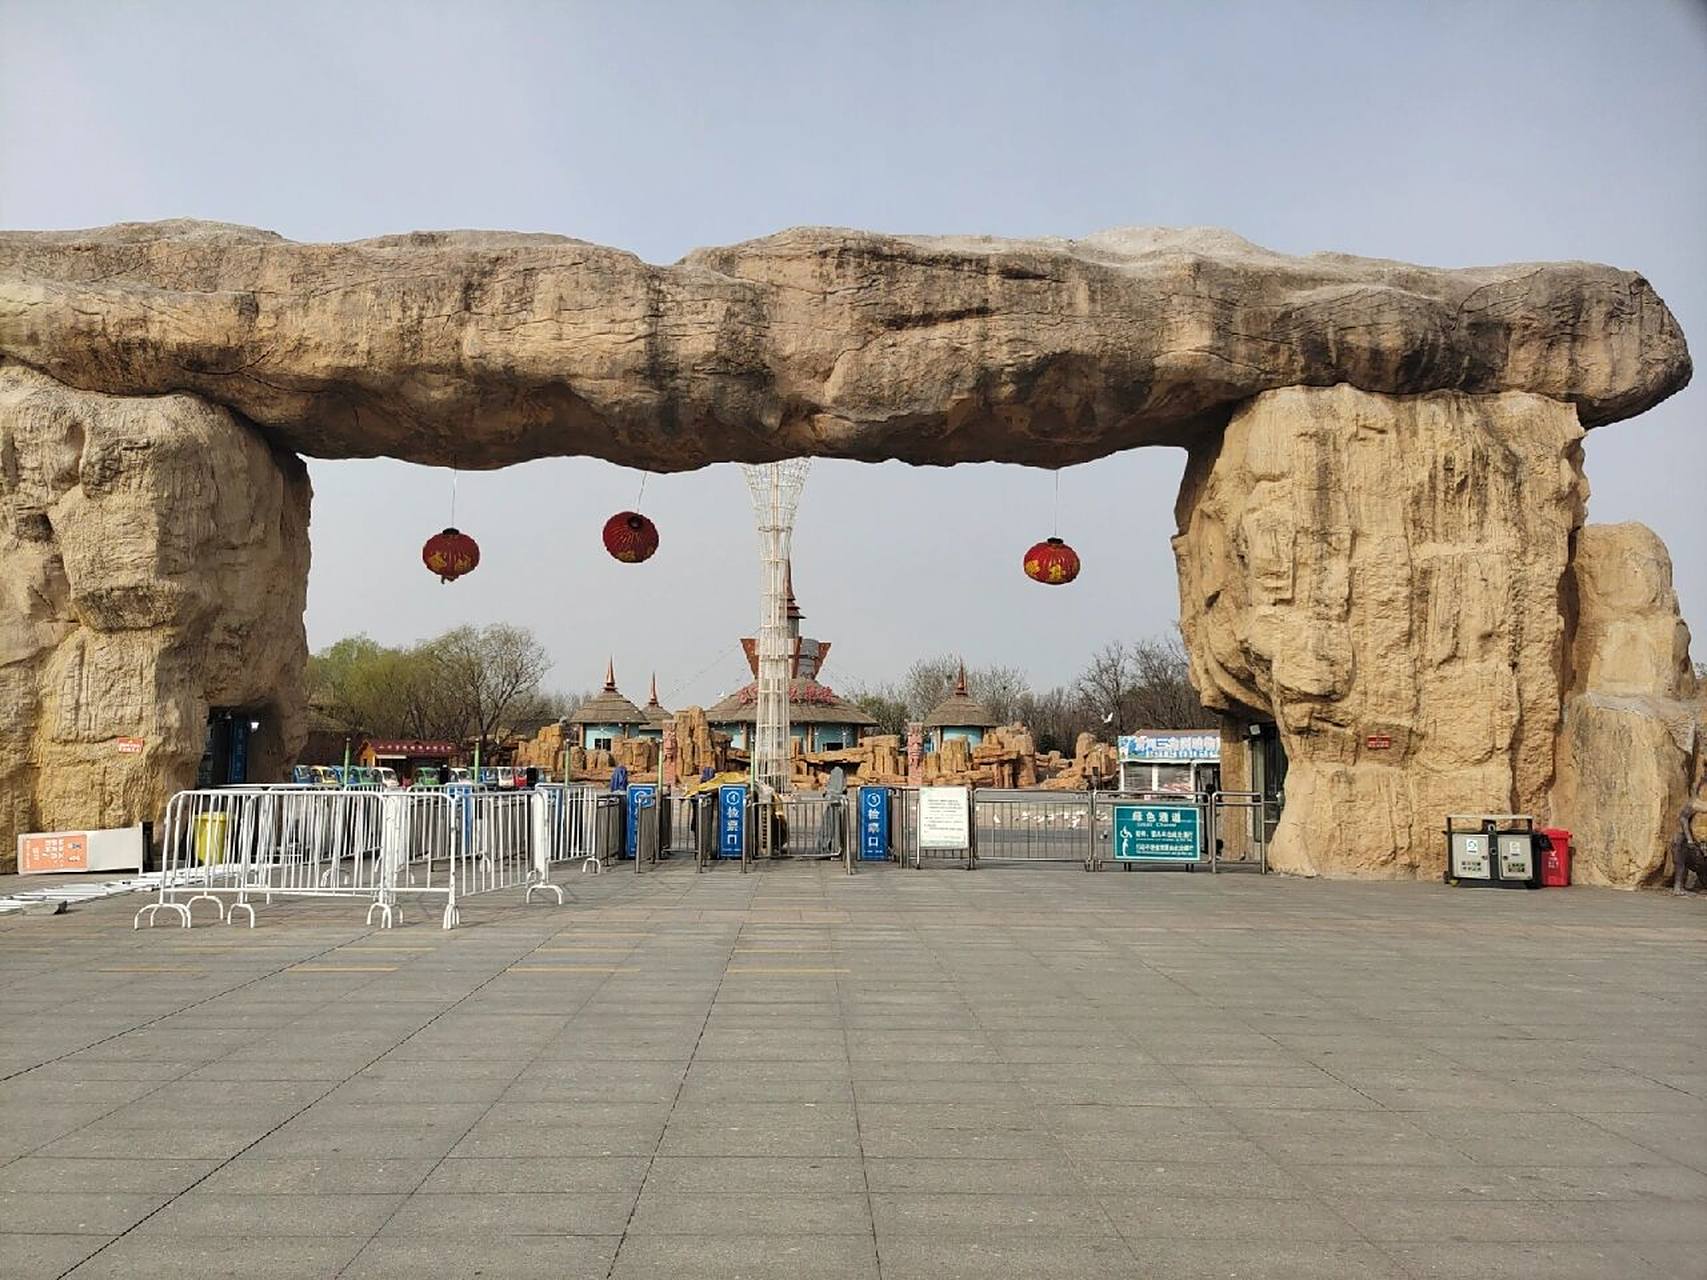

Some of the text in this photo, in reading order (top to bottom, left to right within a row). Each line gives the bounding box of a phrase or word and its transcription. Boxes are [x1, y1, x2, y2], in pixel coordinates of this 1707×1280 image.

[868, 809, 880, 847] 检票口
[1132, 811, 1181, 823] 绿色通道
